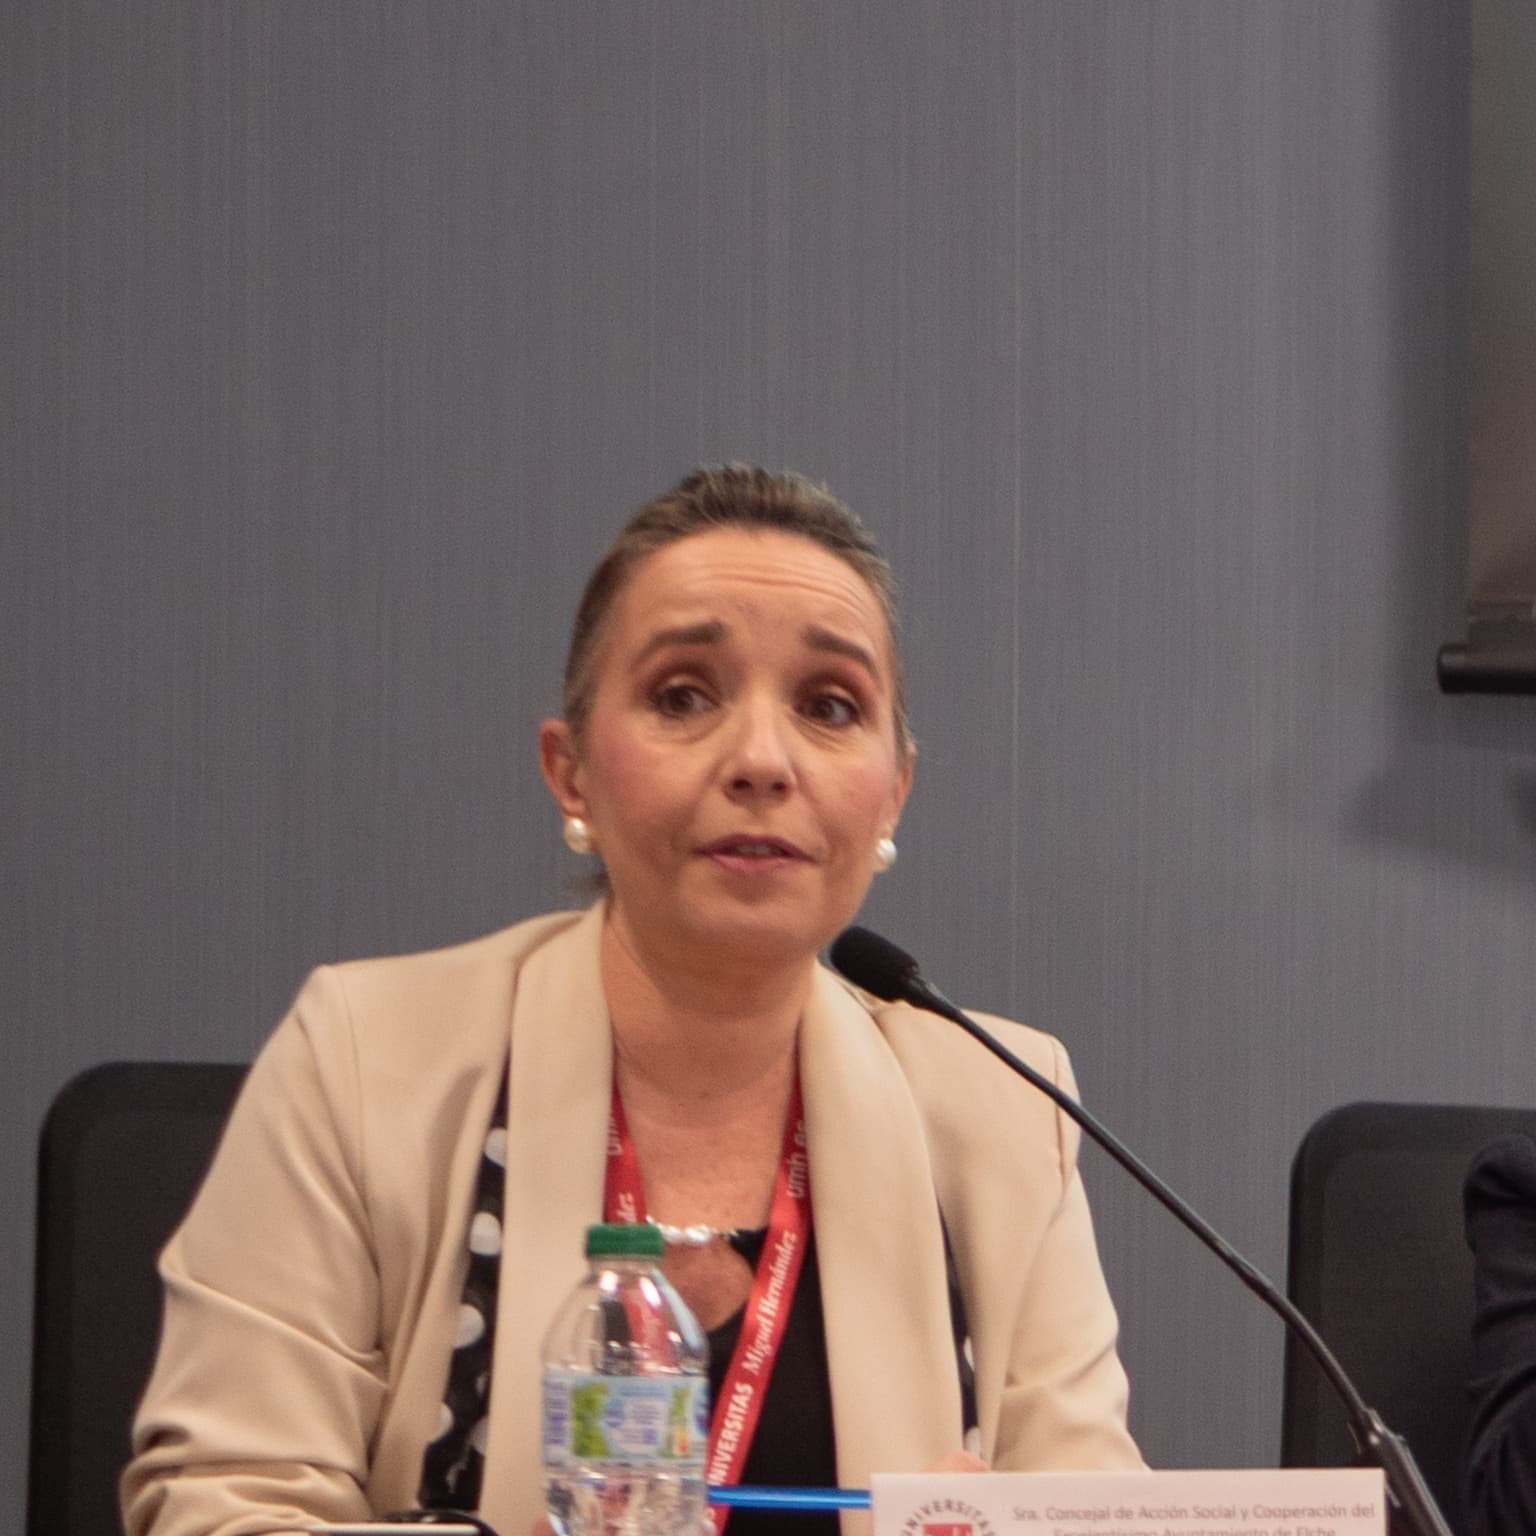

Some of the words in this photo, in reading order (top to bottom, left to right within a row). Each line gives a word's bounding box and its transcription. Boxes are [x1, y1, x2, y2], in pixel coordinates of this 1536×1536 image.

[706, 1382, 754, 1486] NIVERSITAS
[743, 1312, 774, 1375] Miguel
[761, 1231, 797, 1315] Hernández
[1013, 1506, 1039, 1520] Sra.
[1045, 1505, 1110, 1523] Concejal
[1115, 1505, 1134, 1520] de
[1139, 1505, 1187, 1520] Acción
[1192, 1504, 1236, 1519] Social
[1240, 1507, 1249, 1521] y
[1253, 1504, 1347, 1522] Cooperación
[1351, 1503, 1375, 1518] del
